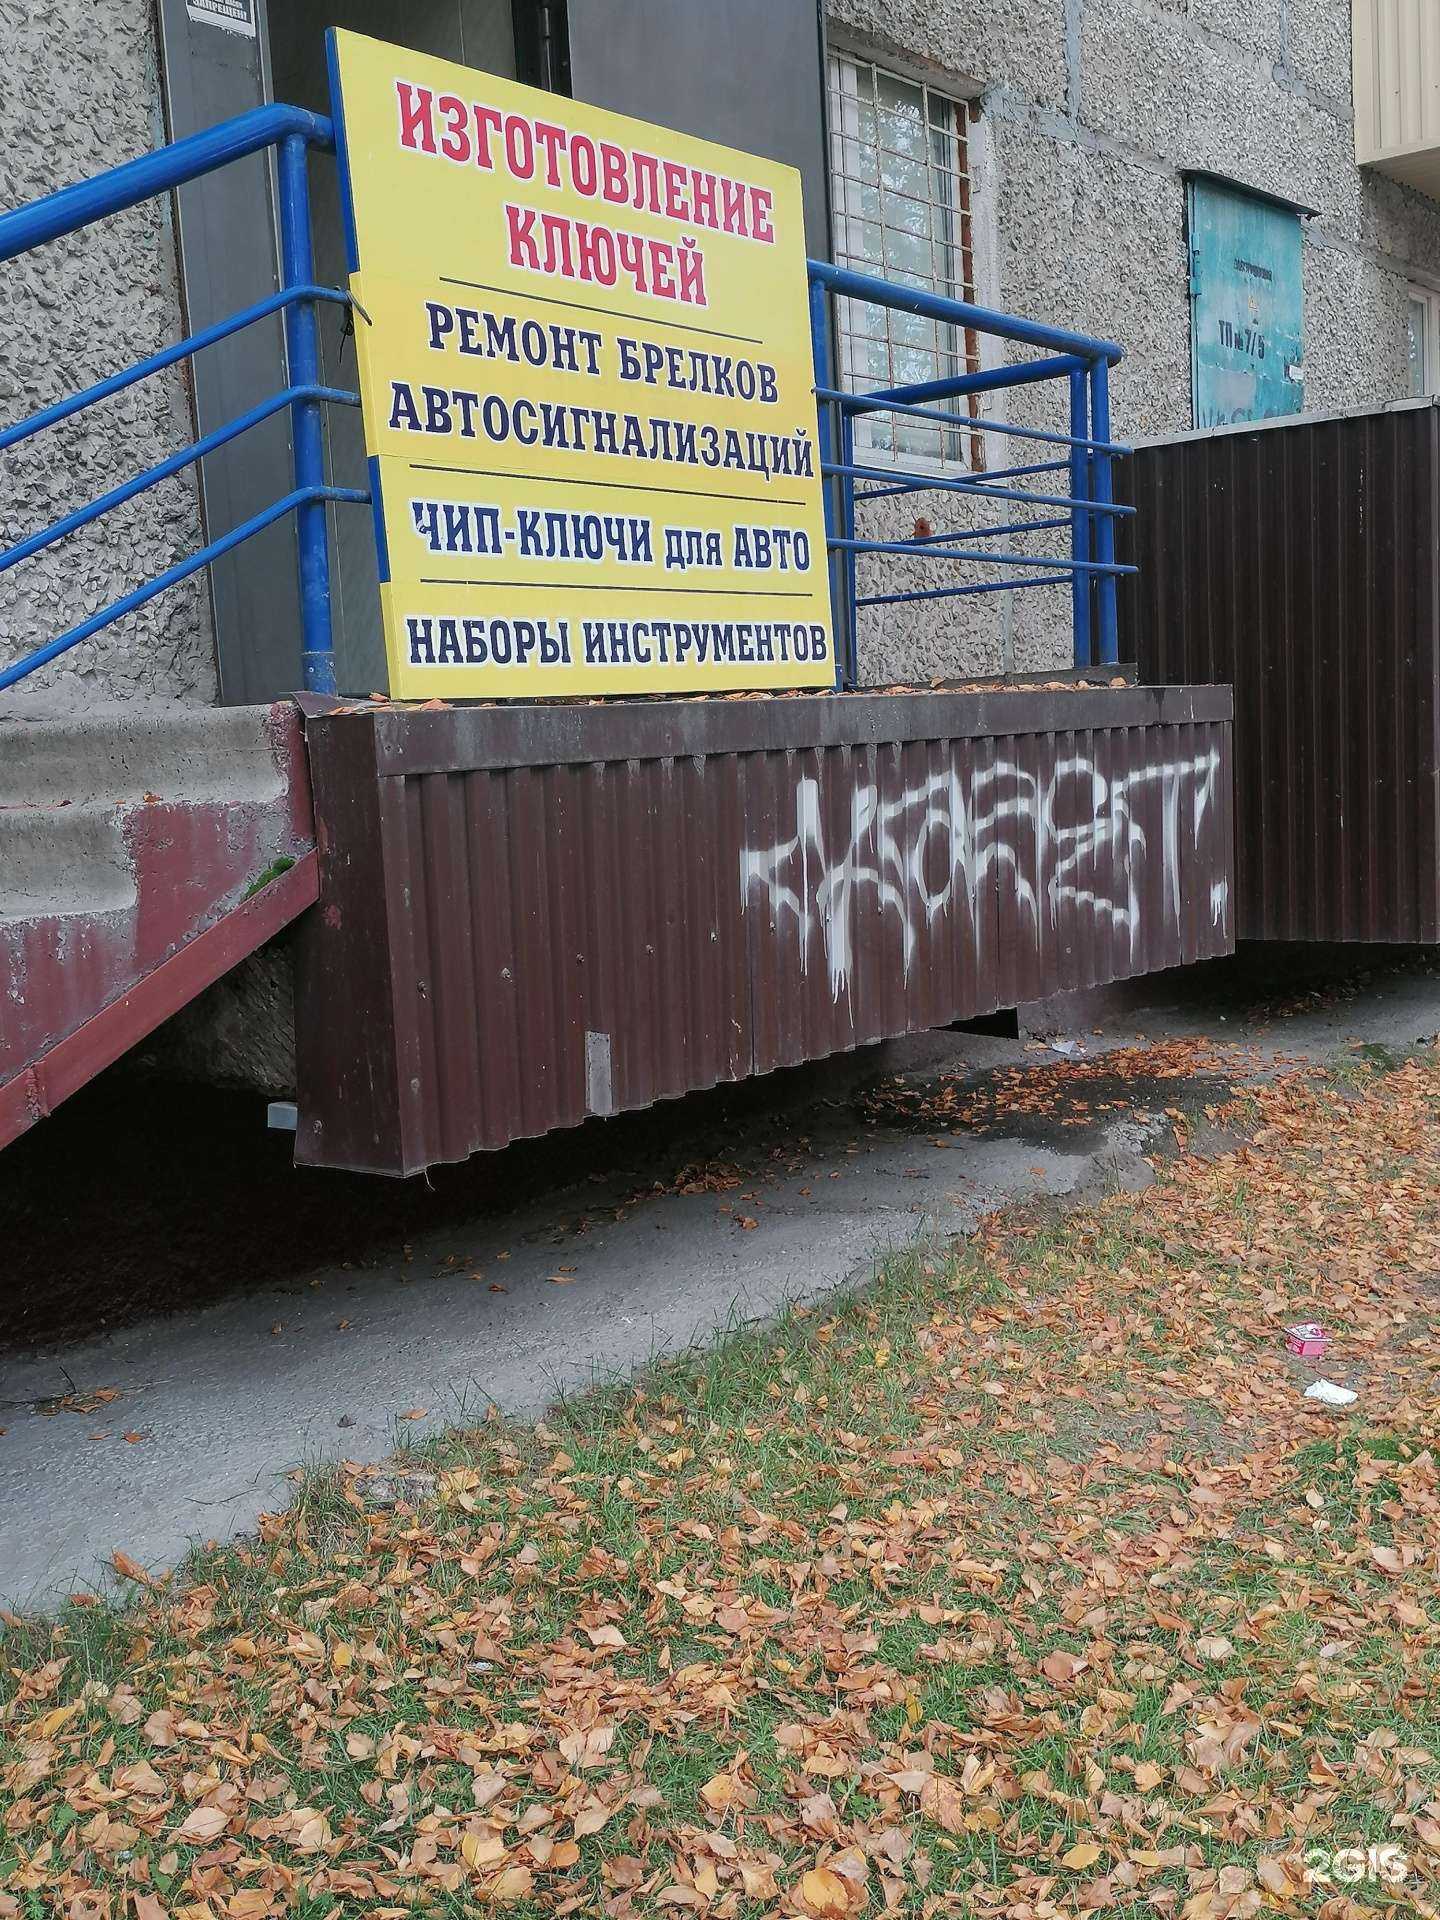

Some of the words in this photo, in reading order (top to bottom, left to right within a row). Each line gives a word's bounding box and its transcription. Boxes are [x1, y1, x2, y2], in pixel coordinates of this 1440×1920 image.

[396, 82, 774, 243] ИЗГОТОВЛЕНИЕ
[506, 204, 706, 305] КЛЮЧЕЙ
[426, 302, 601, 375] РЕМОНТ
[617, 338, 777, 402] БРЕЛКОВ
[389, 381, 814, 481] АВТОСИГНАЛИЗАЦИЙ
[412, 502, 653, 563] ЧИП-КЛЮЧИ
[665, 529, 722, 570] для
[734, 527, 809, 571] АВТО
[407, 618, 571, 664] НАБОРЫ
[584, 622, 827, 664] ИНСТРУМЕНТОВ
